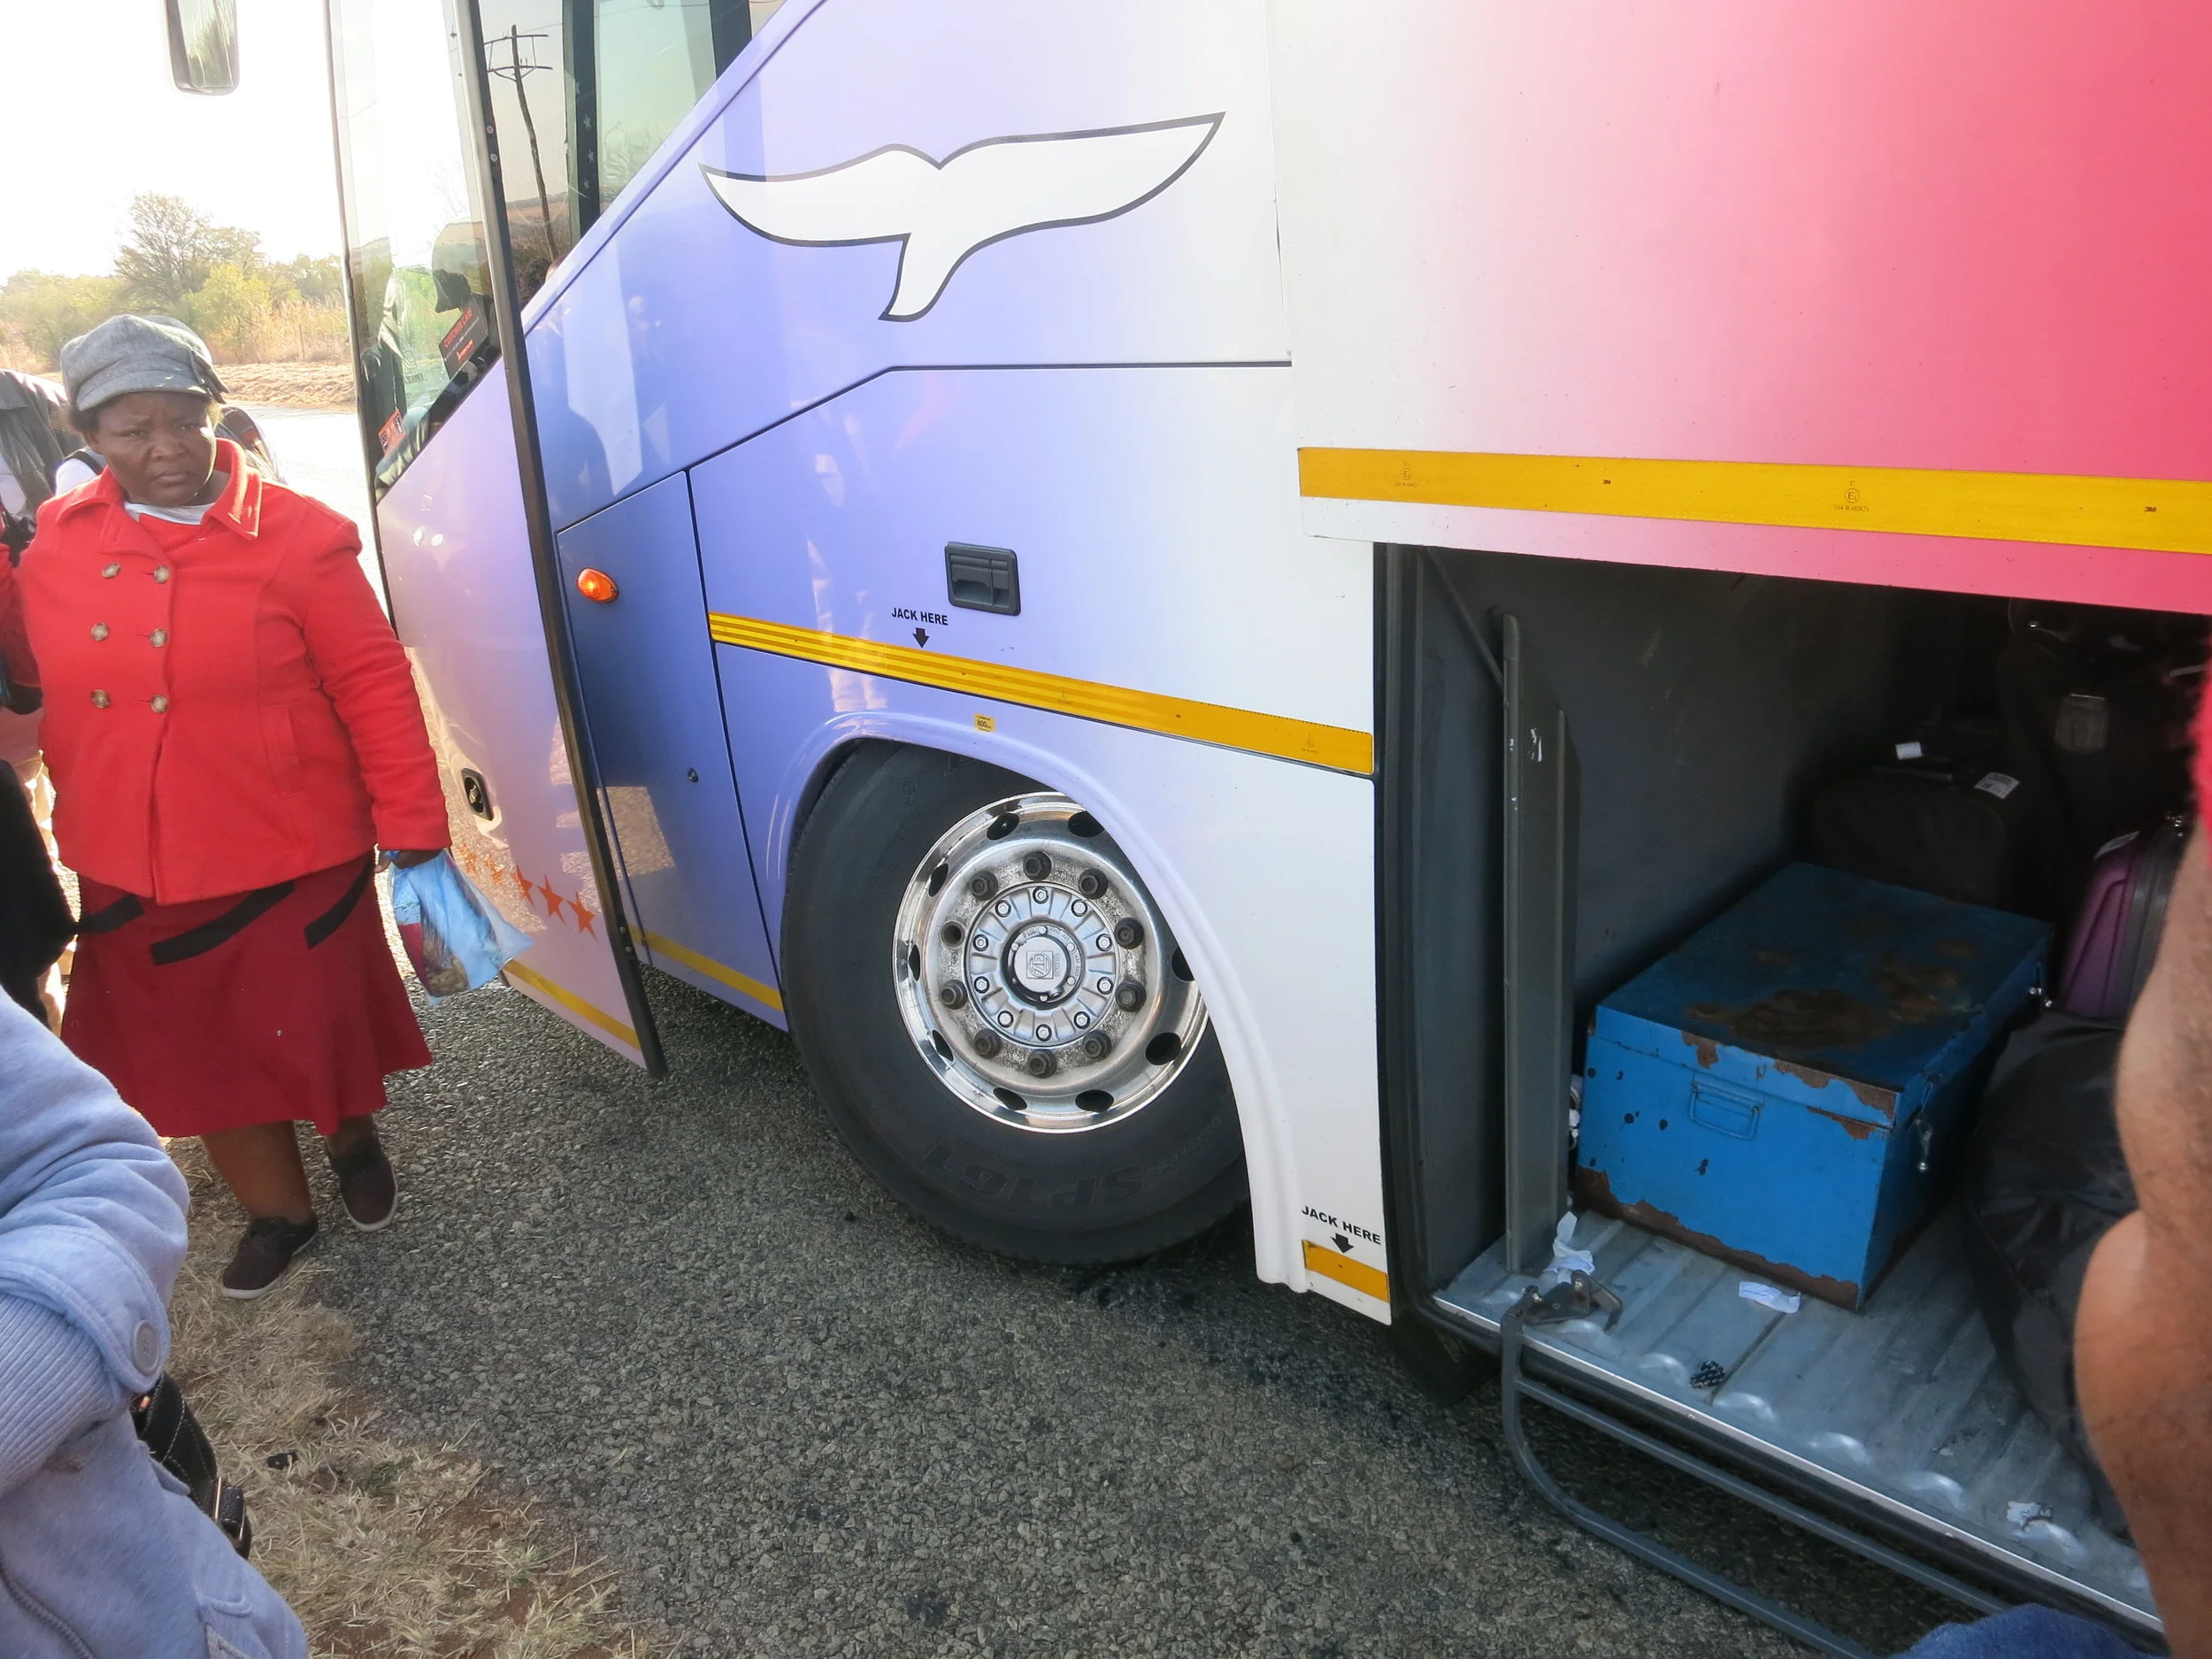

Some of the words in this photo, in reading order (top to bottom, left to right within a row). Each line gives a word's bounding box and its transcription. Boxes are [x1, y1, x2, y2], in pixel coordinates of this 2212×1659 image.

[891, 607, 918, 621] JACK
[920, 611, 949, 626] HERE
[1302, 1205, 1338, 1228] JACK
[1342, 1221, 1382, 1245] HERE
